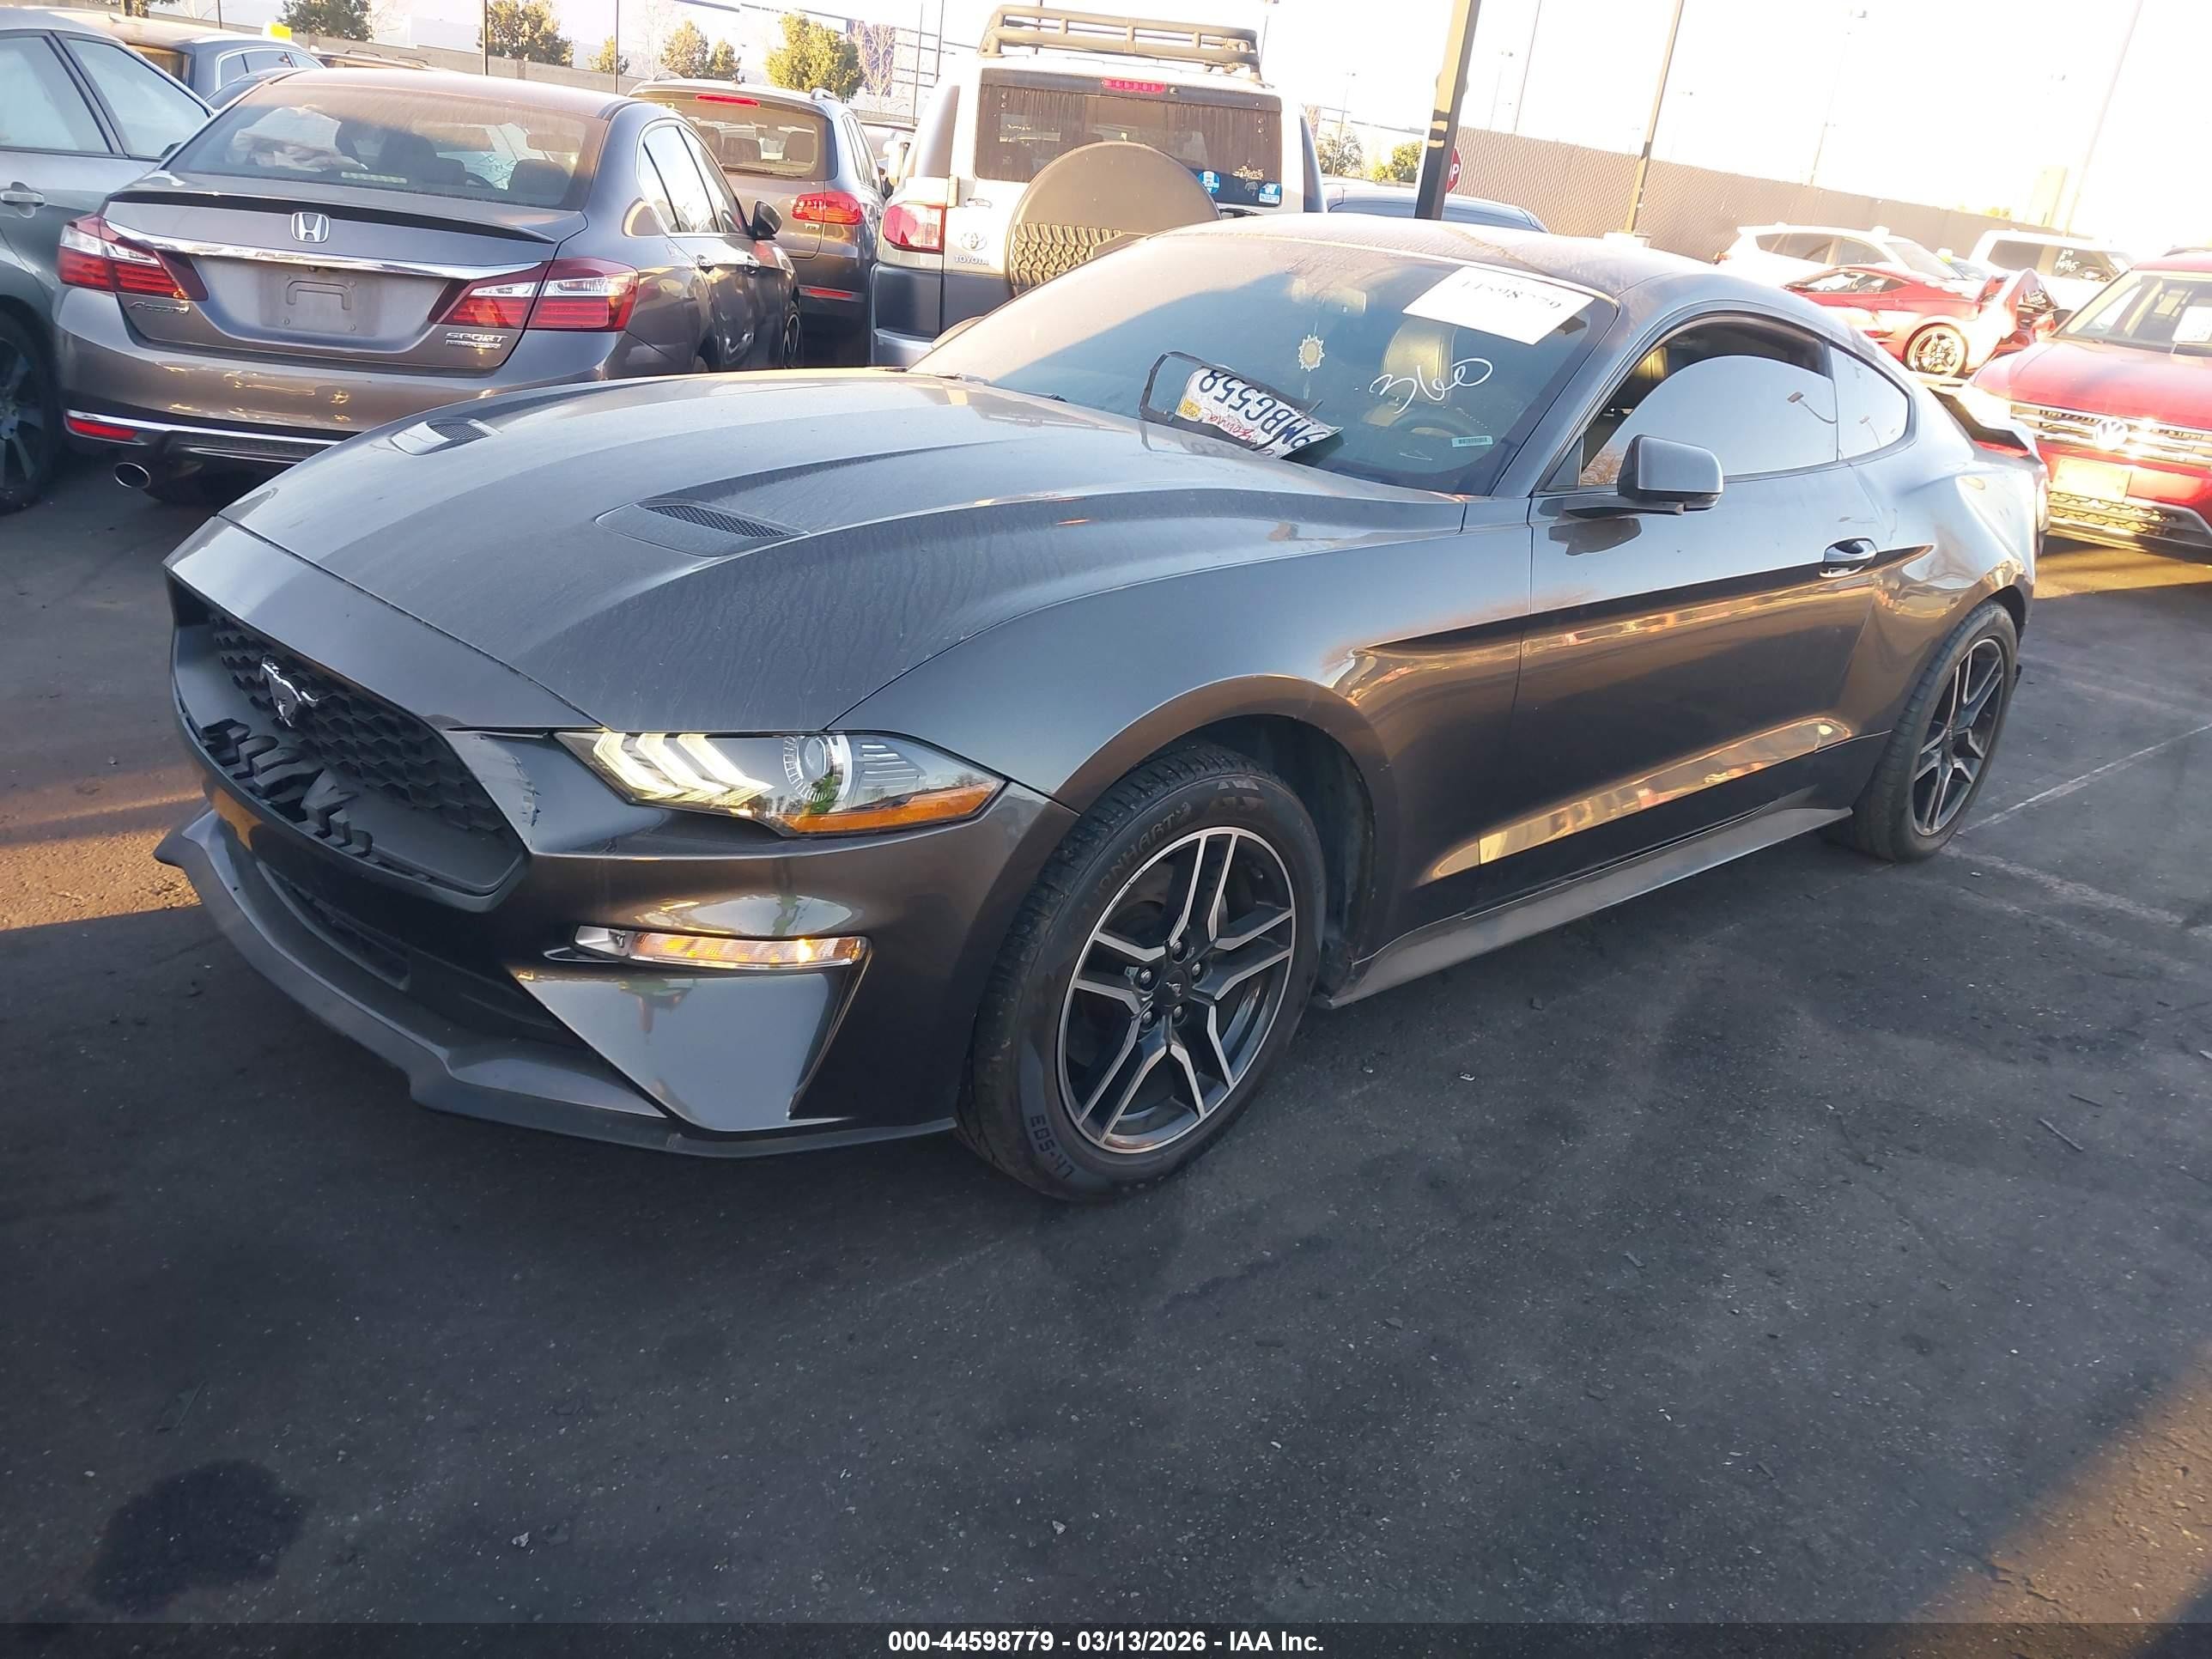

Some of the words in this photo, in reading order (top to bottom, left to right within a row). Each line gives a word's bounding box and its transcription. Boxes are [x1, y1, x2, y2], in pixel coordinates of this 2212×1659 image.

[955, 255, 989, 265] TOYOTA
[445, 332, 509, 342] SPORT
[1199, 369, 1327, 449] 9MBG558
[1201, 407, 1274, 455] Cfornia
